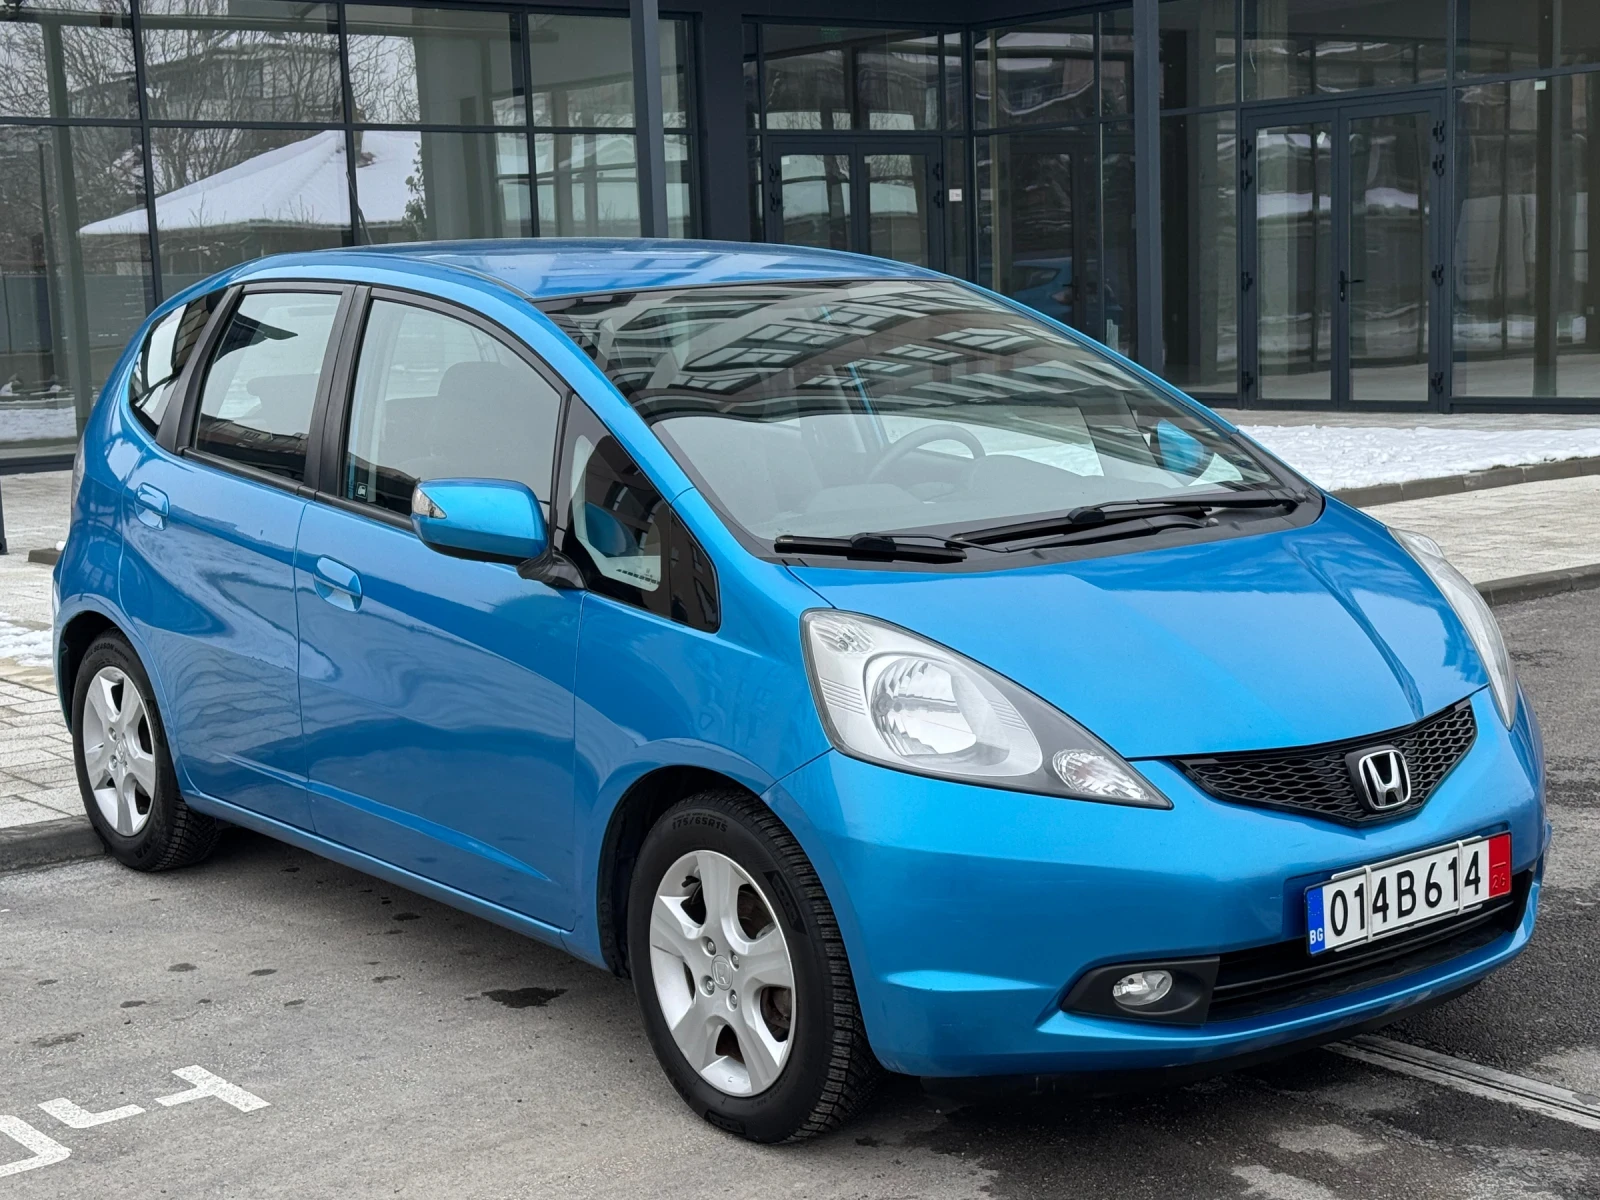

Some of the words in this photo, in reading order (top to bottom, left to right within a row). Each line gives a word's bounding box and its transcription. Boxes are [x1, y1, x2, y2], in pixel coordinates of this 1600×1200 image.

[672, 816, 728, 833] 175/65R15
[1330, 850, 1482, 937] 014B614
[1309, 927, 1324, 945] BG
